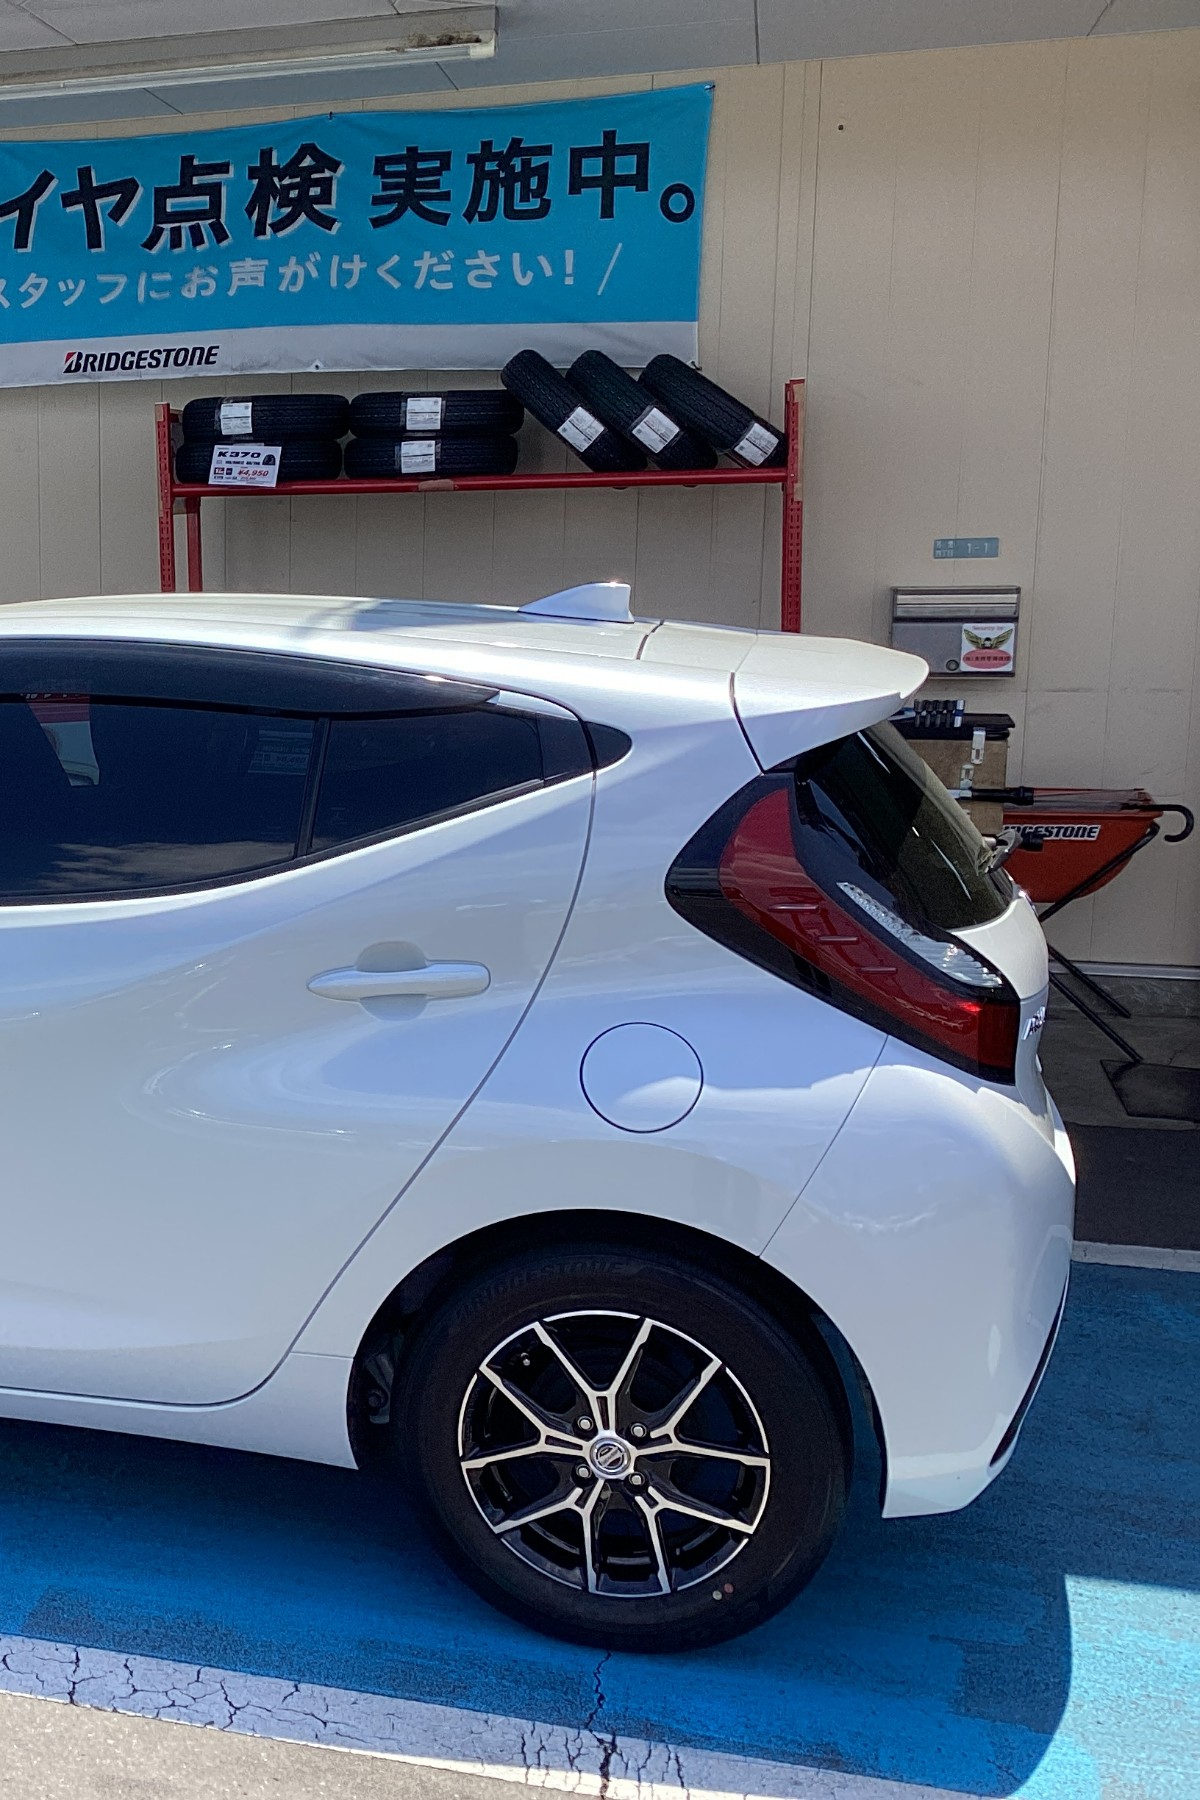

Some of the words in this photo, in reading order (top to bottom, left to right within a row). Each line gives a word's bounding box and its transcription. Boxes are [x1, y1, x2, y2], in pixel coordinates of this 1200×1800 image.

[368, 129, 696, 230] 実施中。
[62, 345, 220, 374] BRIDGESTONE
[237, 469, 270, 477] ¥4,950
[967, 542, 989, 554] 1-1
